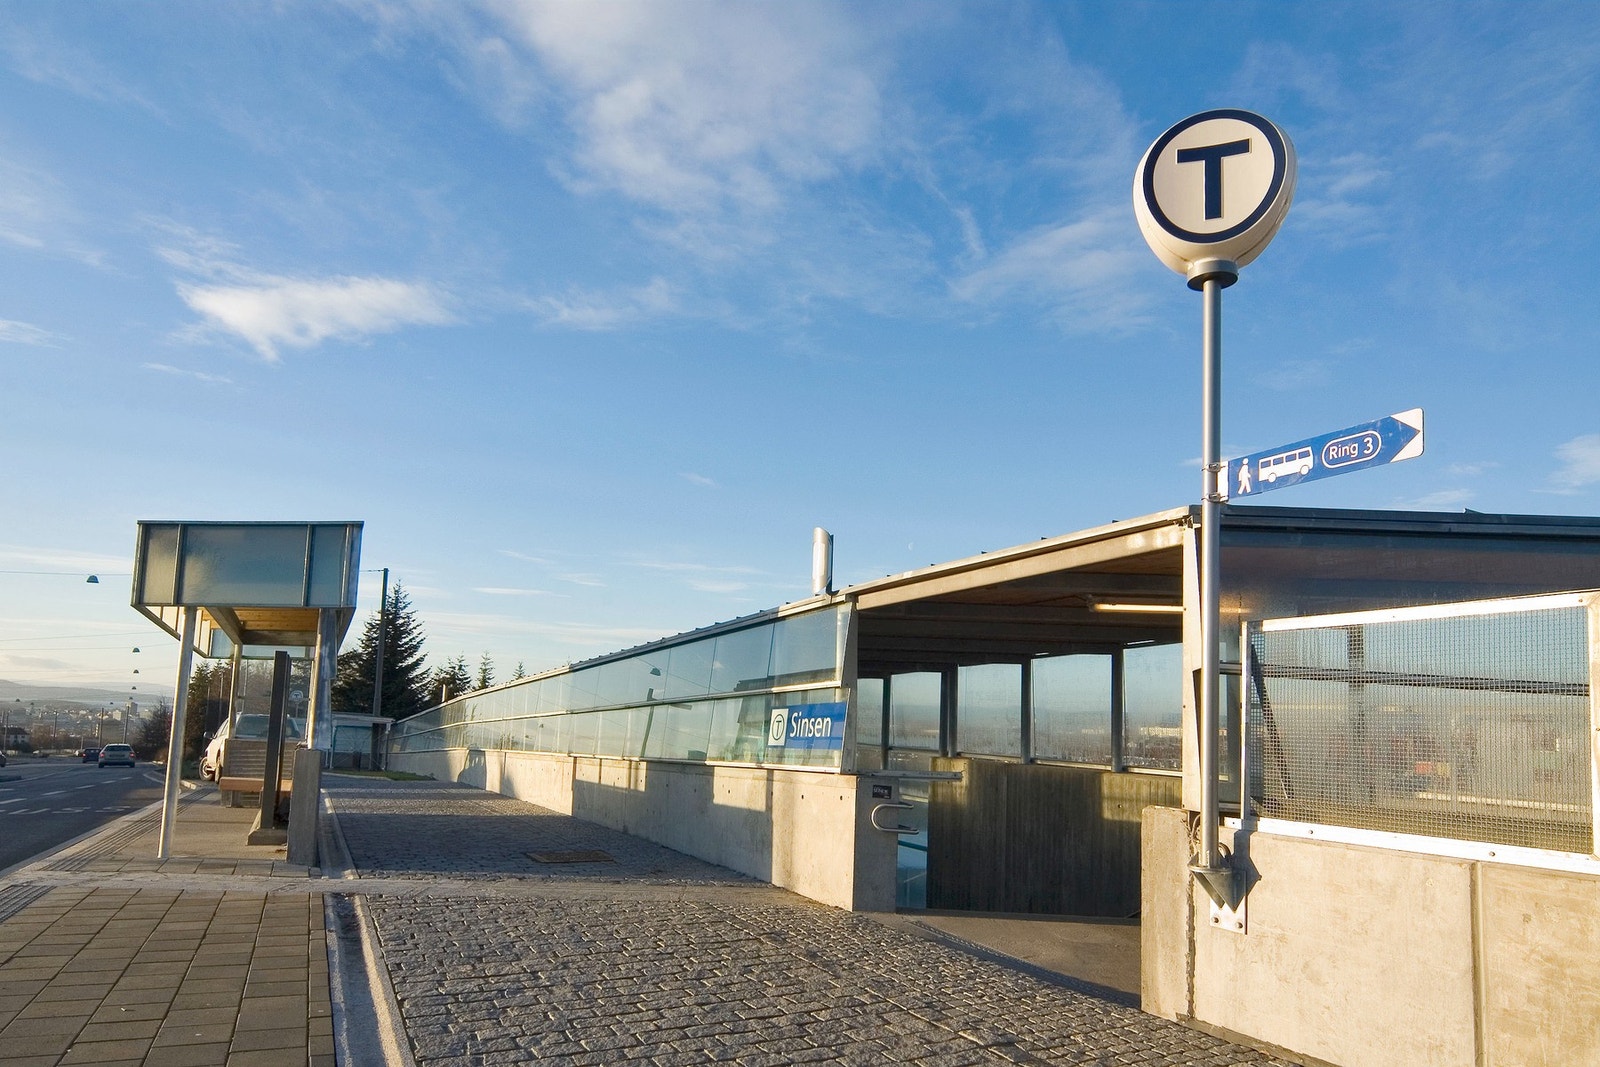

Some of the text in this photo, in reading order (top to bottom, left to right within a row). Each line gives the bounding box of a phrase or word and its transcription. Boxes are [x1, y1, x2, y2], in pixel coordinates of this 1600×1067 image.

[1177, 139, 1250, 220] T
[1329, 437, 1374, 460] Ring 3
[789, 711, 832, 738] Sinsen
[0, 806, 131, 815] USS
